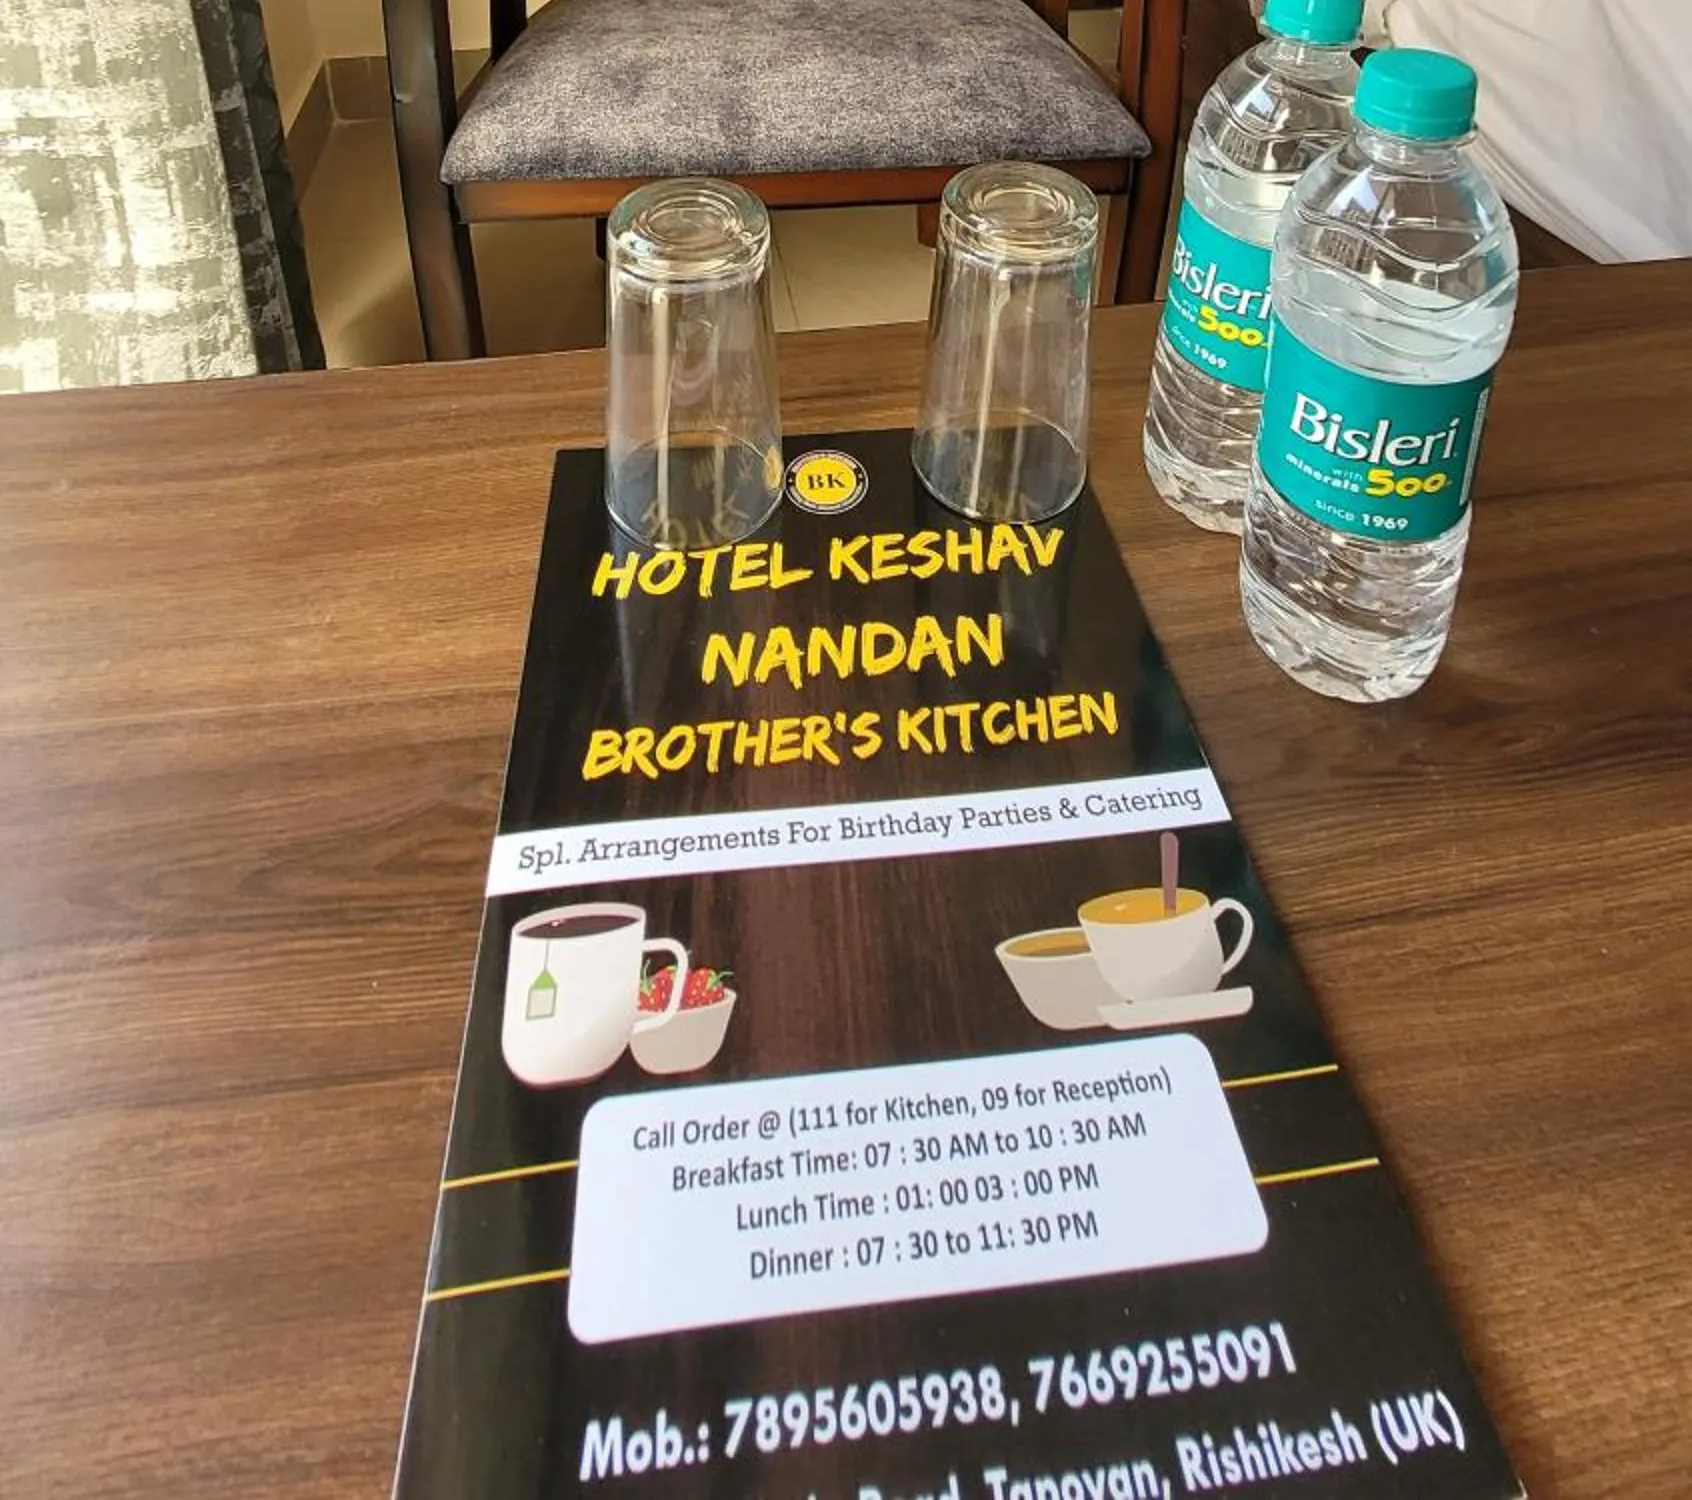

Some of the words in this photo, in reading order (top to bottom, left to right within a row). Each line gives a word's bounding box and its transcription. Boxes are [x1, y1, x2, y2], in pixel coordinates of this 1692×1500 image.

[1173, 235, 1271, 320] Bisleri
[1197, 305, 1263, 346] 500
[1290, 391, 1460, 466] Bisleri
[808, 472, 846, 490] BK
[1285, 453, 1360, 493] minerals
[1365, 468, 1448, 497] 500
[1314, 499, 1354, 522] since
[1361, 513, 1409, 531] 1969
[591, 541, 815, 600] HOTEL
[829, 521, 1064, 584] KESHAV
[701, 613, 1004, 690] NANDAN
[582, 710, 883, 781] BROTHER'S
[897, 691, 1119, 754] KITCHEN
[518, 842, 571, 874] Spl.
[577, 828, 781, 862] Arrangements
[788, 820, 832, 844] For
[840, 811, 952, 840] Birthday
[959, 802, 1051, 829] Parties
[1059, 797, 1080, 819] &
[1085, 786, 1203, 817] Catering
[633, 1121, 675, 1151] Call
[683, 1115, 750, 1145] Order
[758, 1110, 781, 1139] @
[789, 1104, 838, 1138] (111
[846, 1100, 879, 1126] for
[885, 1093, 977, 1123] Kitchen,
[982, 1087, 1009, 1112] 09
[1015, 1083, 1047, 1108] for
[1053, 1064, 1172, 1103] Reception)
[672, 1155, 784, 1191] Breakfast
[790, 1148, 857, 1176] Time:
[914, 1136, 941, 1163] 30
[950, 1131, 989, 1161] AM
[995, 1132, 1019, 1153] to
[1026, 1123, 1053, 1150] 10
[1071, 1118, 1100, 1144] 30
[1107, 1111, 1147, 1140] AM
[736, 1195, 807, 1231] Lunch
[814, 1192, 875, 1221] Time
[1059, 1162, 1099, 1192] PM
[750, 1247, 834, 1280] Dinner
[908, 1229, 938, 1260] 30
[945, 1229, 970, 1255] to
[1057, 1210, 1099, 1241] PM
[579, 1409, 710, 1482] Mob.:
[724, 1363, 1020, 1459] 7895605938,
[1028, 1321, 1297, 1414] 7669255091
[1175, 1407, 1368, 1493] Rishikesh
[1370, 1388, 1467, 1465] (UK)
